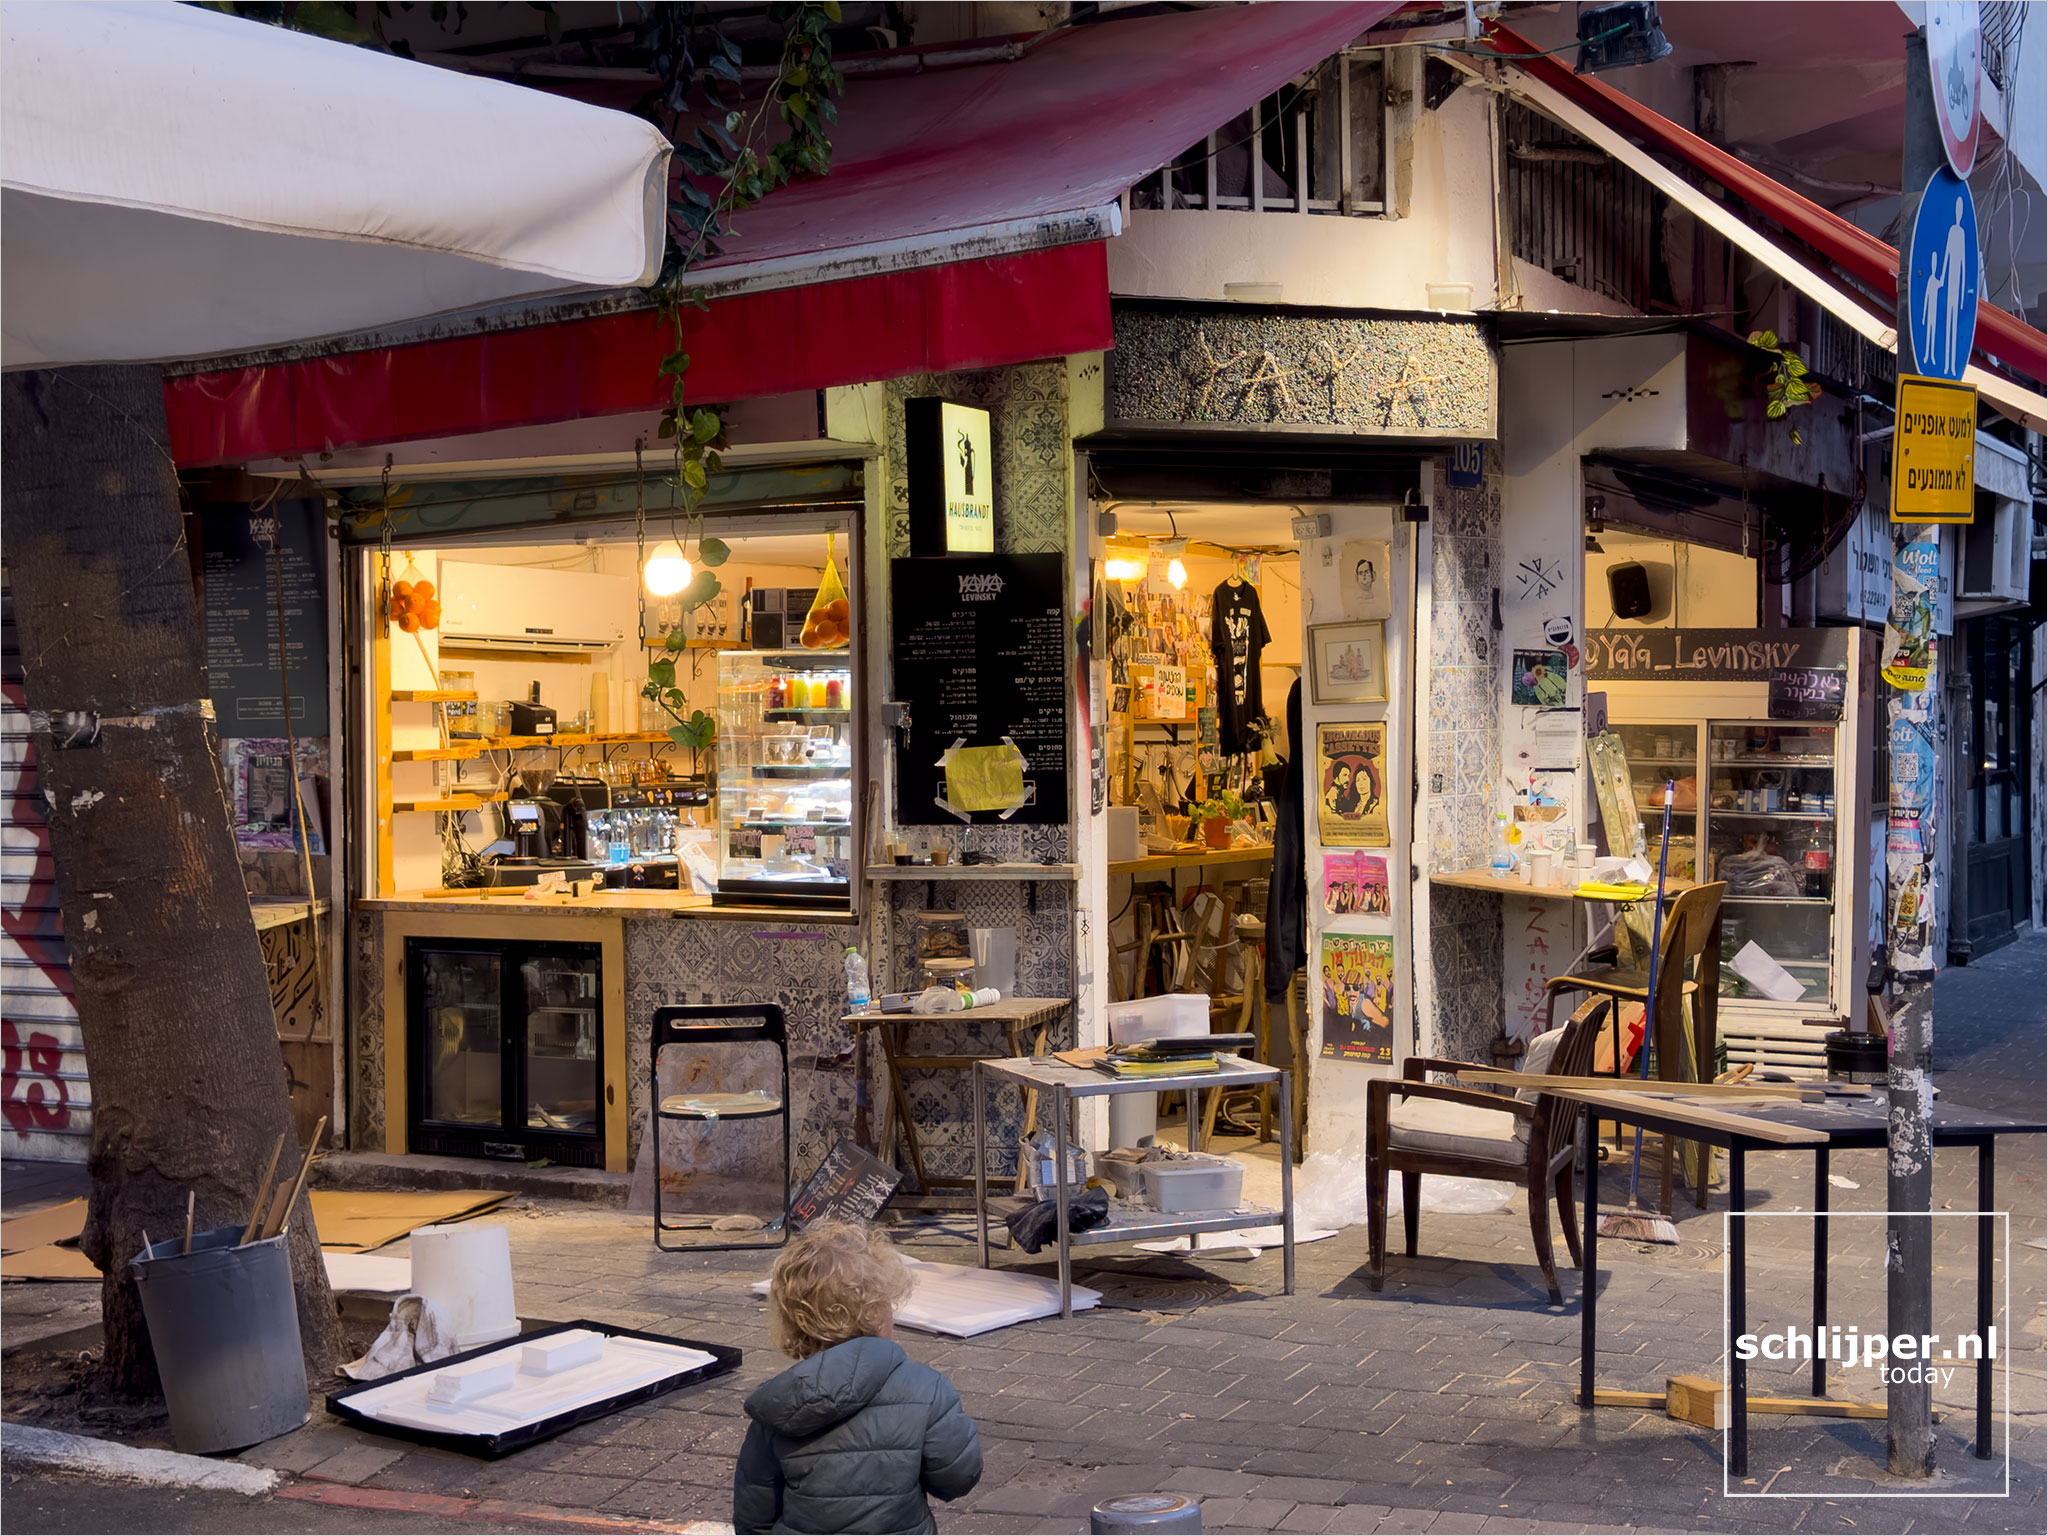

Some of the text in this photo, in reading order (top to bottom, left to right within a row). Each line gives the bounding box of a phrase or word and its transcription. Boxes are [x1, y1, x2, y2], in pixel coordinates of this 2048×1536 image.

[1904, 411, 1971, 439] למעט אופניים
[1453, 441, 1481, 474] 105
[1908, 463, 1966, 492] לא ממונעים
[949, 501, 990, 519] HAUSBRANDT
[1902, 549, 1938, 566] Wolt
[958, 573, 1007, 593] YAYA
[961, 593, 997, 602] LEVINSKY
[1047, 608, 1061, 616] קפה
[1820, 672, 1840, 688] לא
[1783, 686, 1826, 702] במקרר
[1322, 729, 1382, 744] INGLORIOUS
[1892, 727, 1913, 742] olt
[1322, 741, 1382, 755] CASSETTES
[1369, 939, 1391, 954] נשף
